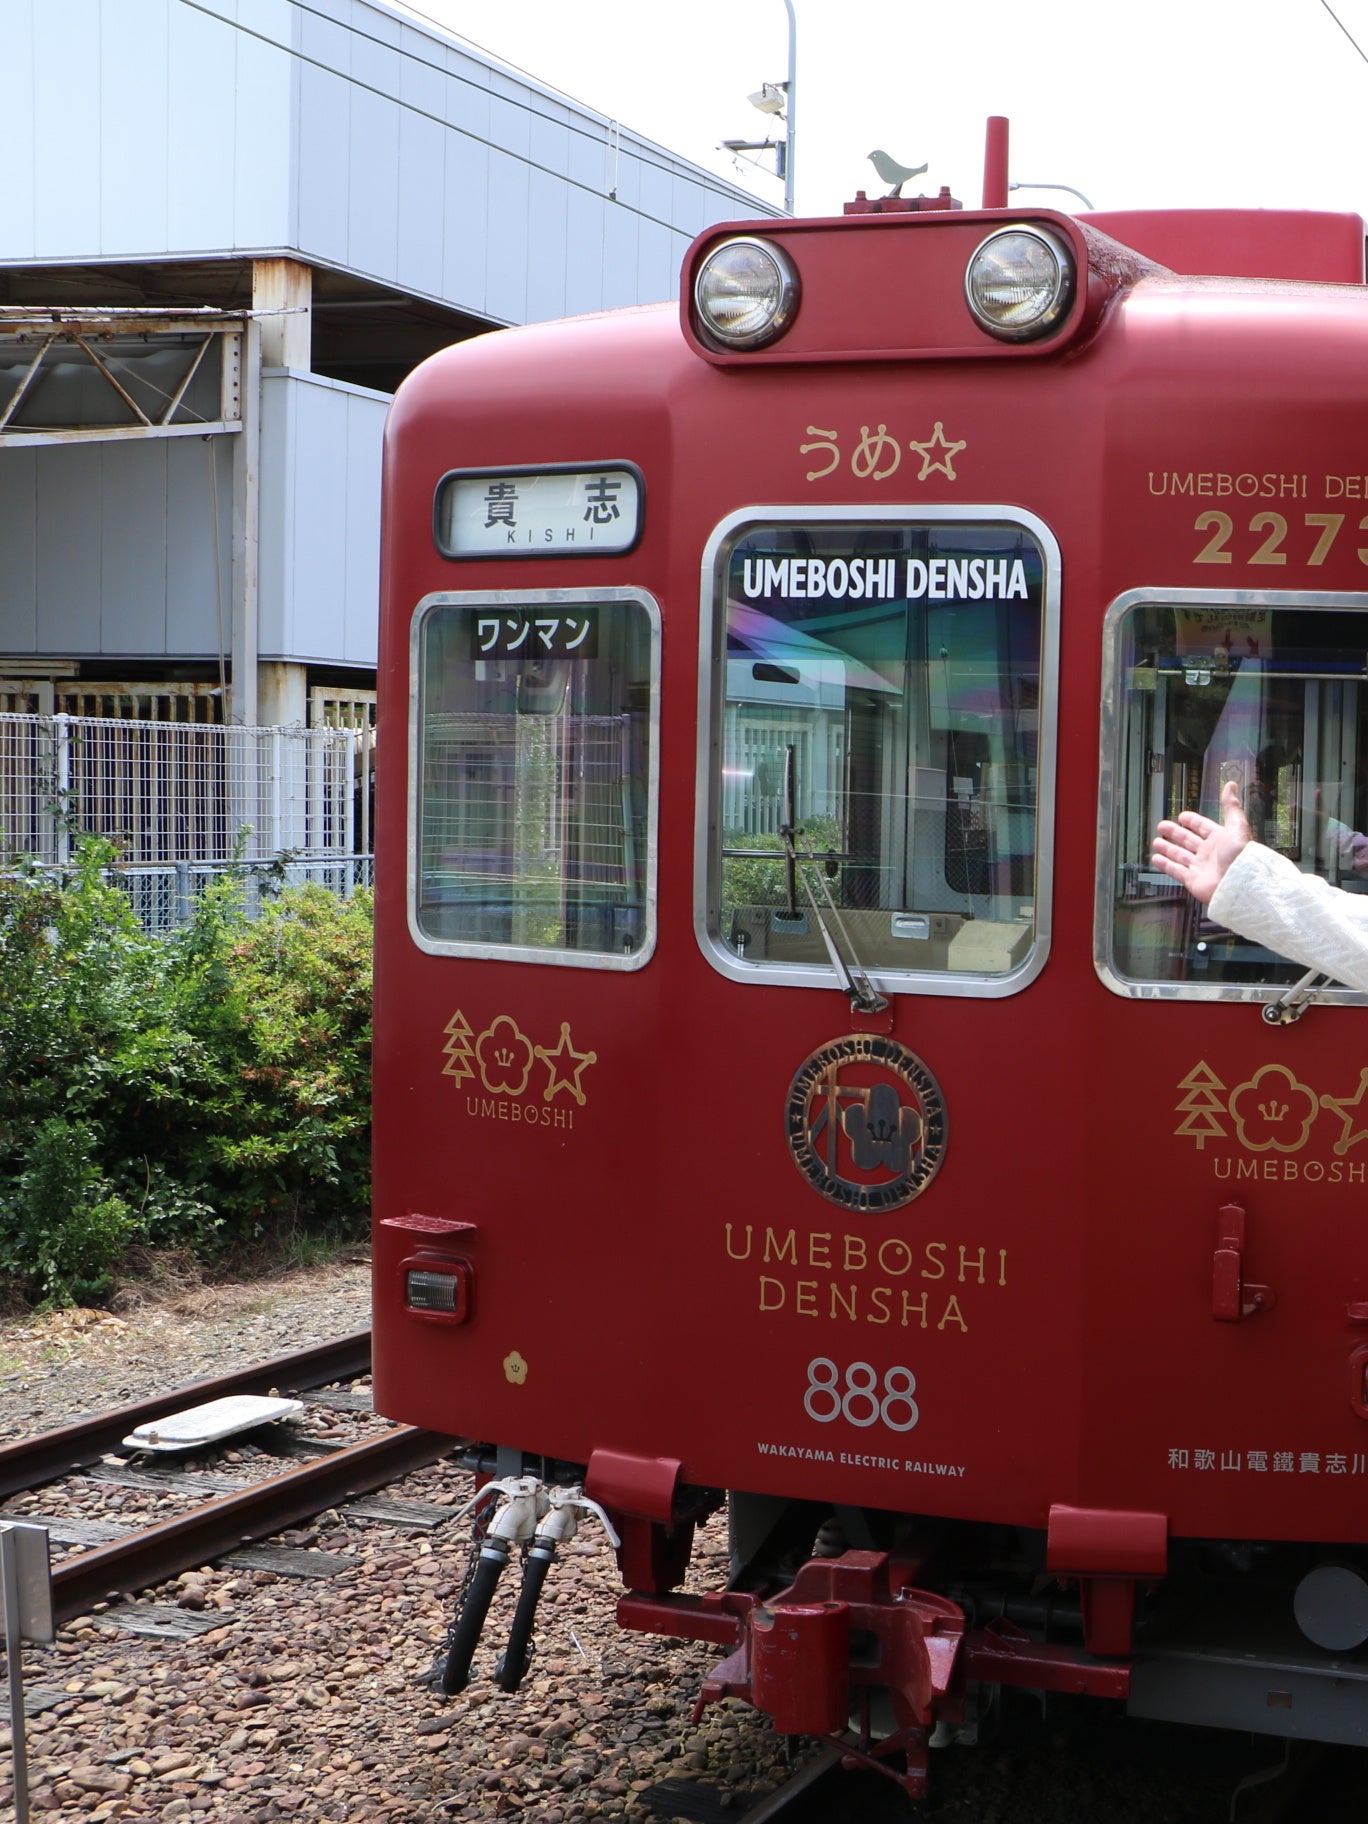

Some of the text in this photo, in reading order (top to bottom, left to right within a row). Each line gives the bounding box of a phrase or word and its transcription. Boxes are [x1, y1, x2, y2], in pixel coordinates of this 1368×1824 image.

[1148, 472, 1307, 498] UMEBOSHI
[507, 527, 594, 544] KISHI
[743, 558, 1028, 600] UMEBOSHI DENSHA
[477, 618, 591, 652] ワンマン
[466, 1096, 574, 1130] UMEBOSHI
[725, 1222, 1007, 1286] UMEBOSHI
[758, 1275, 968, 1333] DENSHA
[803, 1357, 919, 1432] 888
[757, 1442, 966, 1478] WAKAYAMA ELECTRIC RAILWAY
